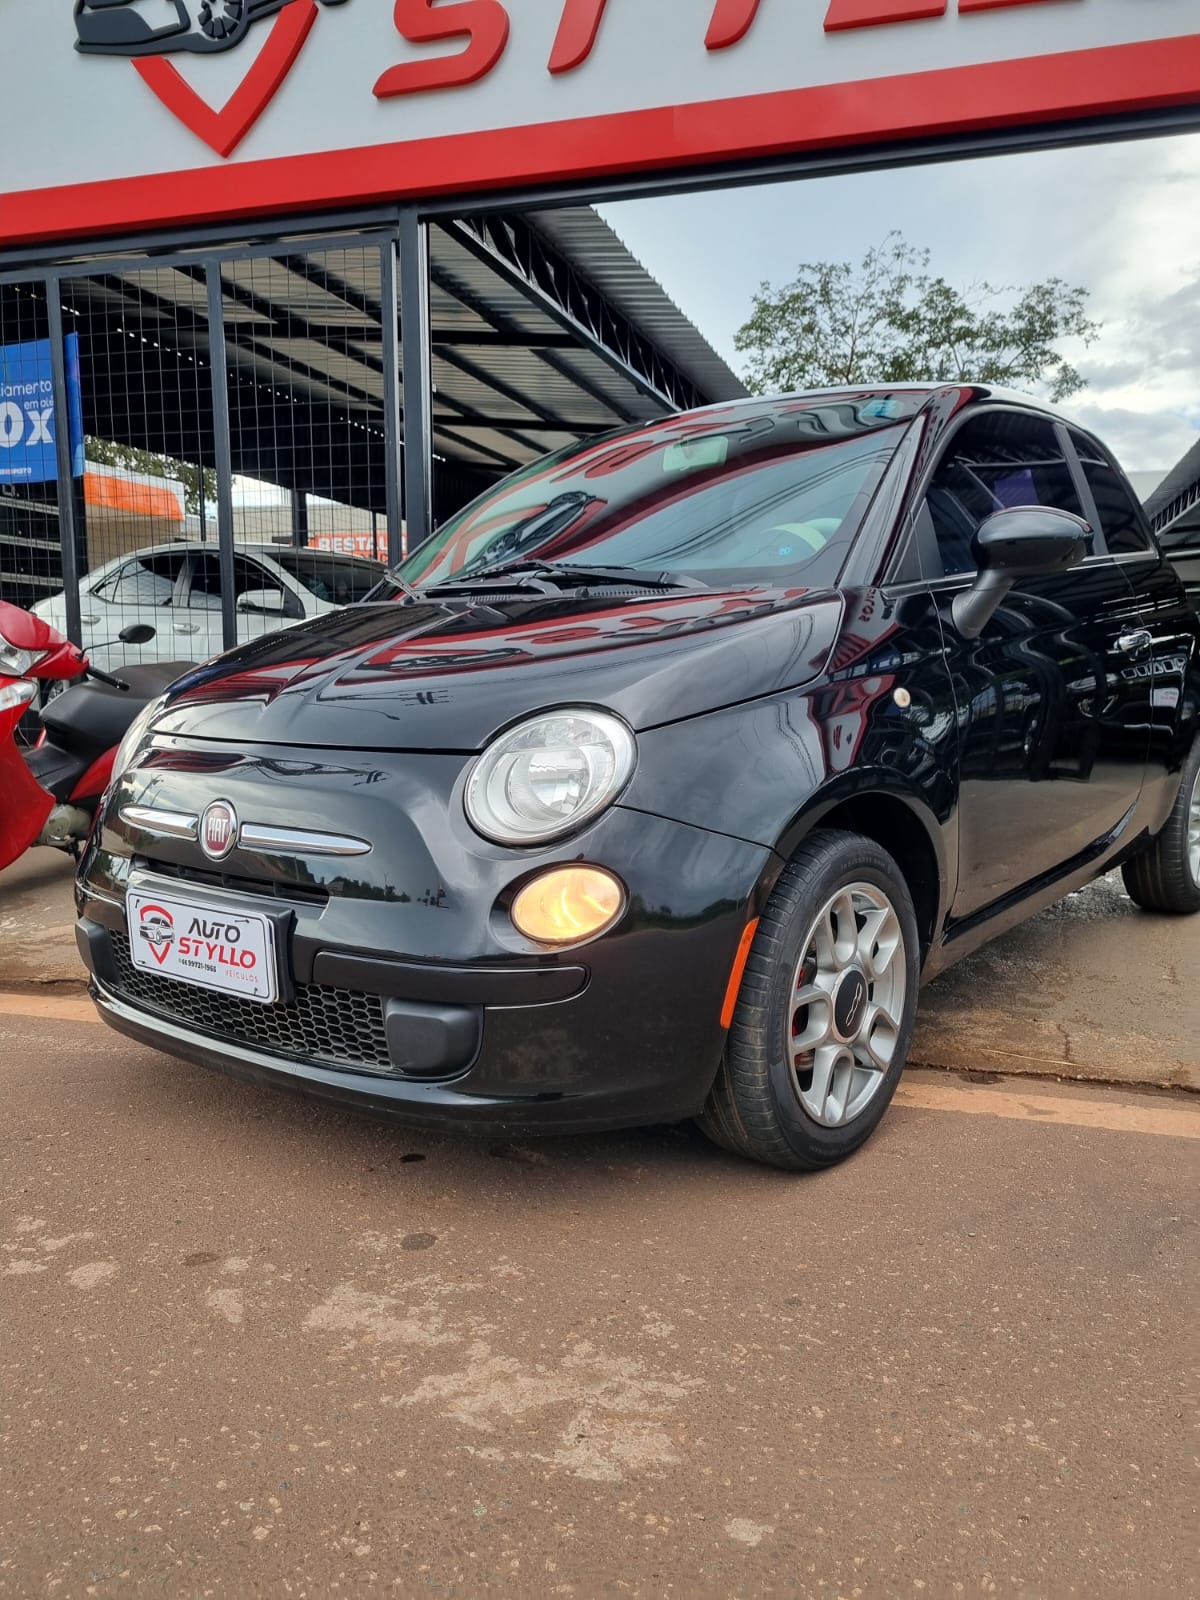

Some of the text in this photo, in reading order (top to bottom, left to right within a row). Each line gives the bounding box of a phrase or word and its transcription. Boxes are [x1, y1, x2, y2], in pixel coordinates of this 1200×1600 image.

[0, 380, 52, 397] iamento
[24, 400, 39, 410] em
[206, 816, 229, 843] FIAT
[188, 917, 241, 944] AUTO
[178, 936, 257, 969] STYLLO
